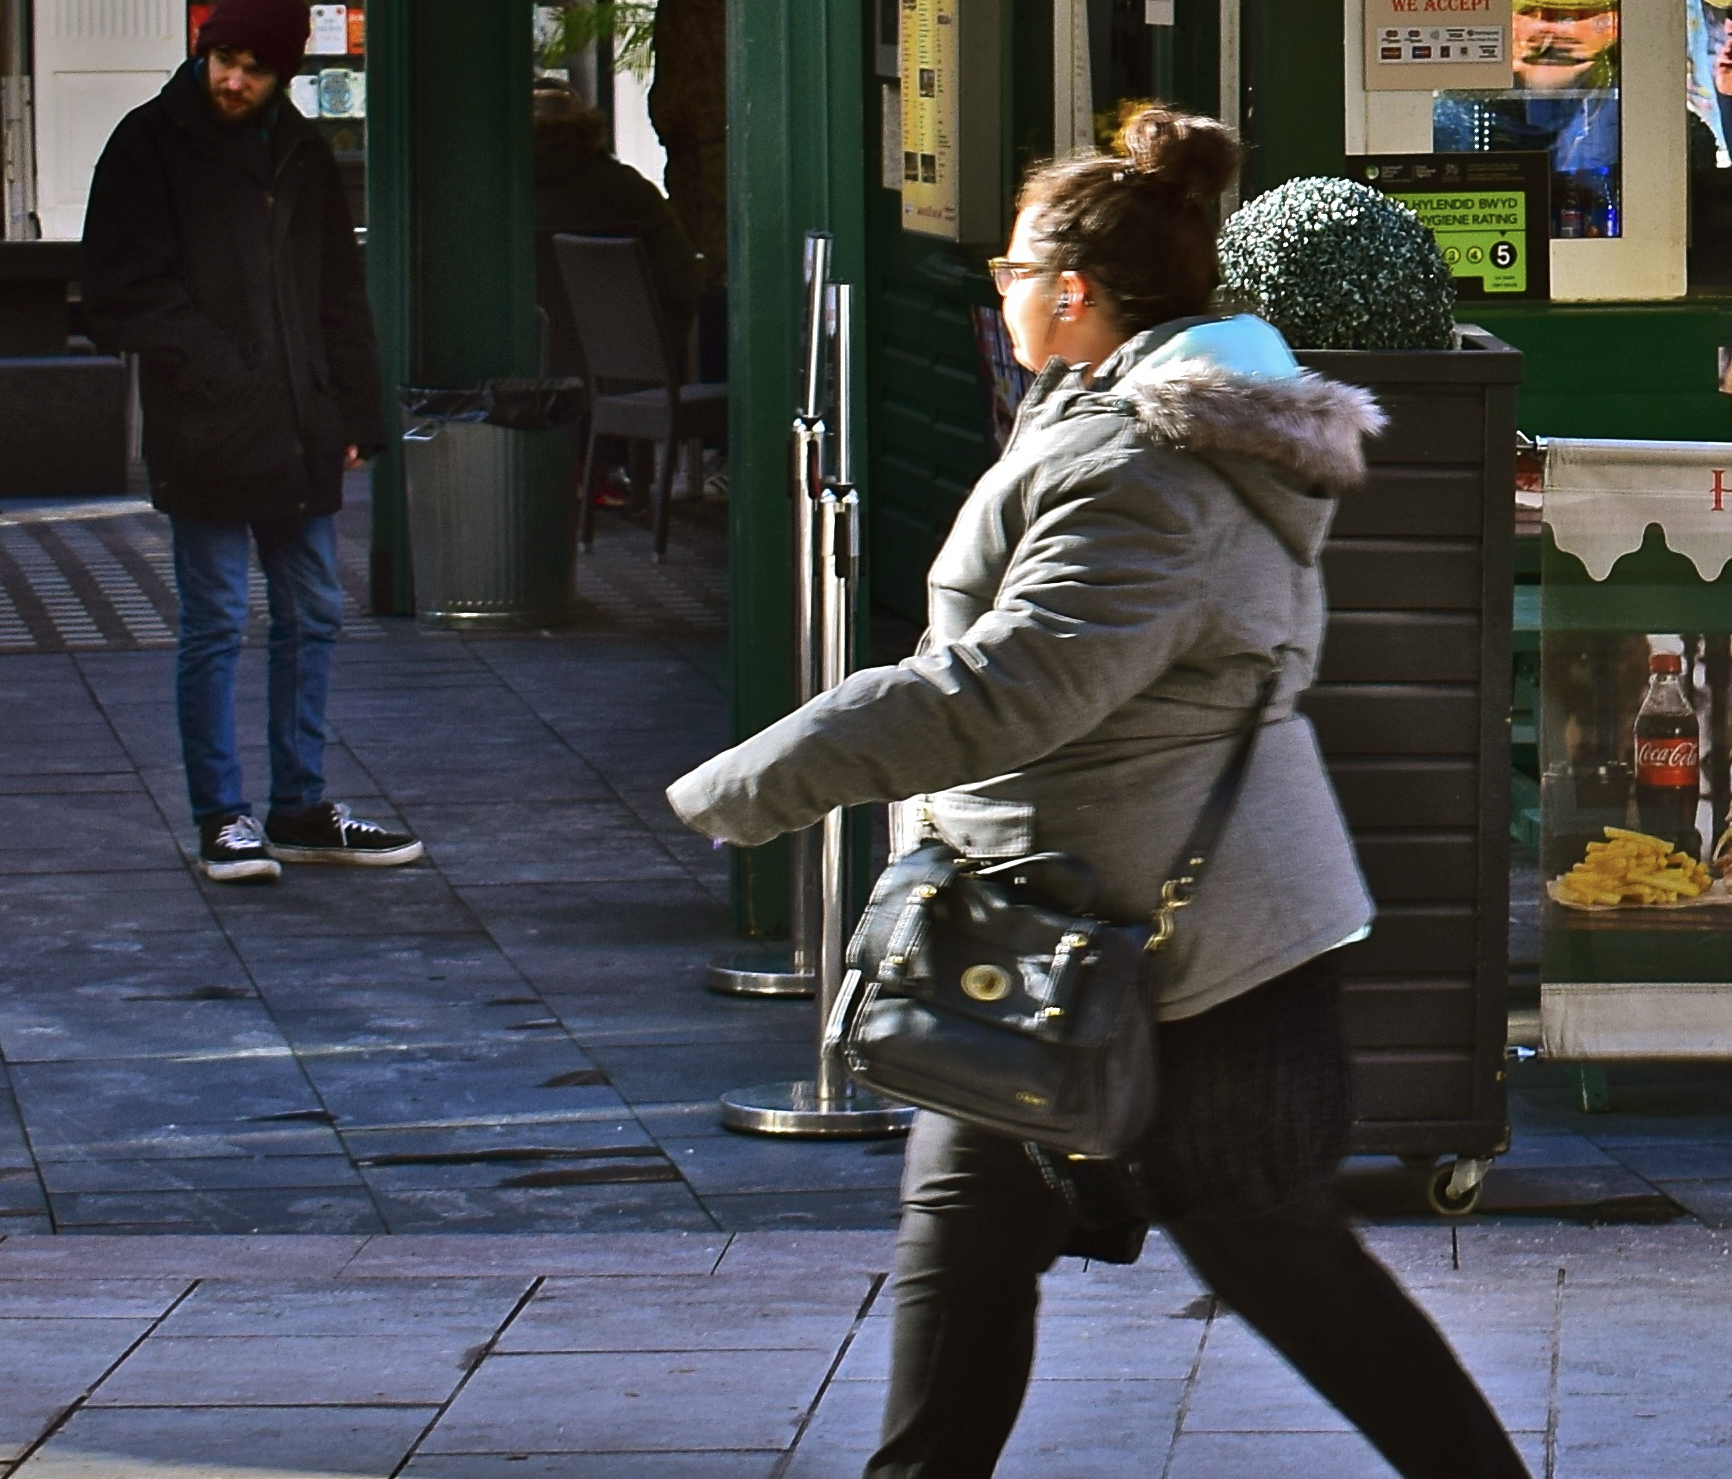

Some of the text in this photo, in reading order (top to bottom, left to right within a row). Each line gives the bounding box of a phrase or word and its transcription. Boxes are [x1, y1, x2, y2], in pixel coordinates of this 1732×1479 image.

[1413, 198, 1474, 210] HYLENDID
[1478, 197, 1518, 209] BWYD
[1471, 213, 1518, 225] RATING
[1496, 245, 1511, 266] 5
